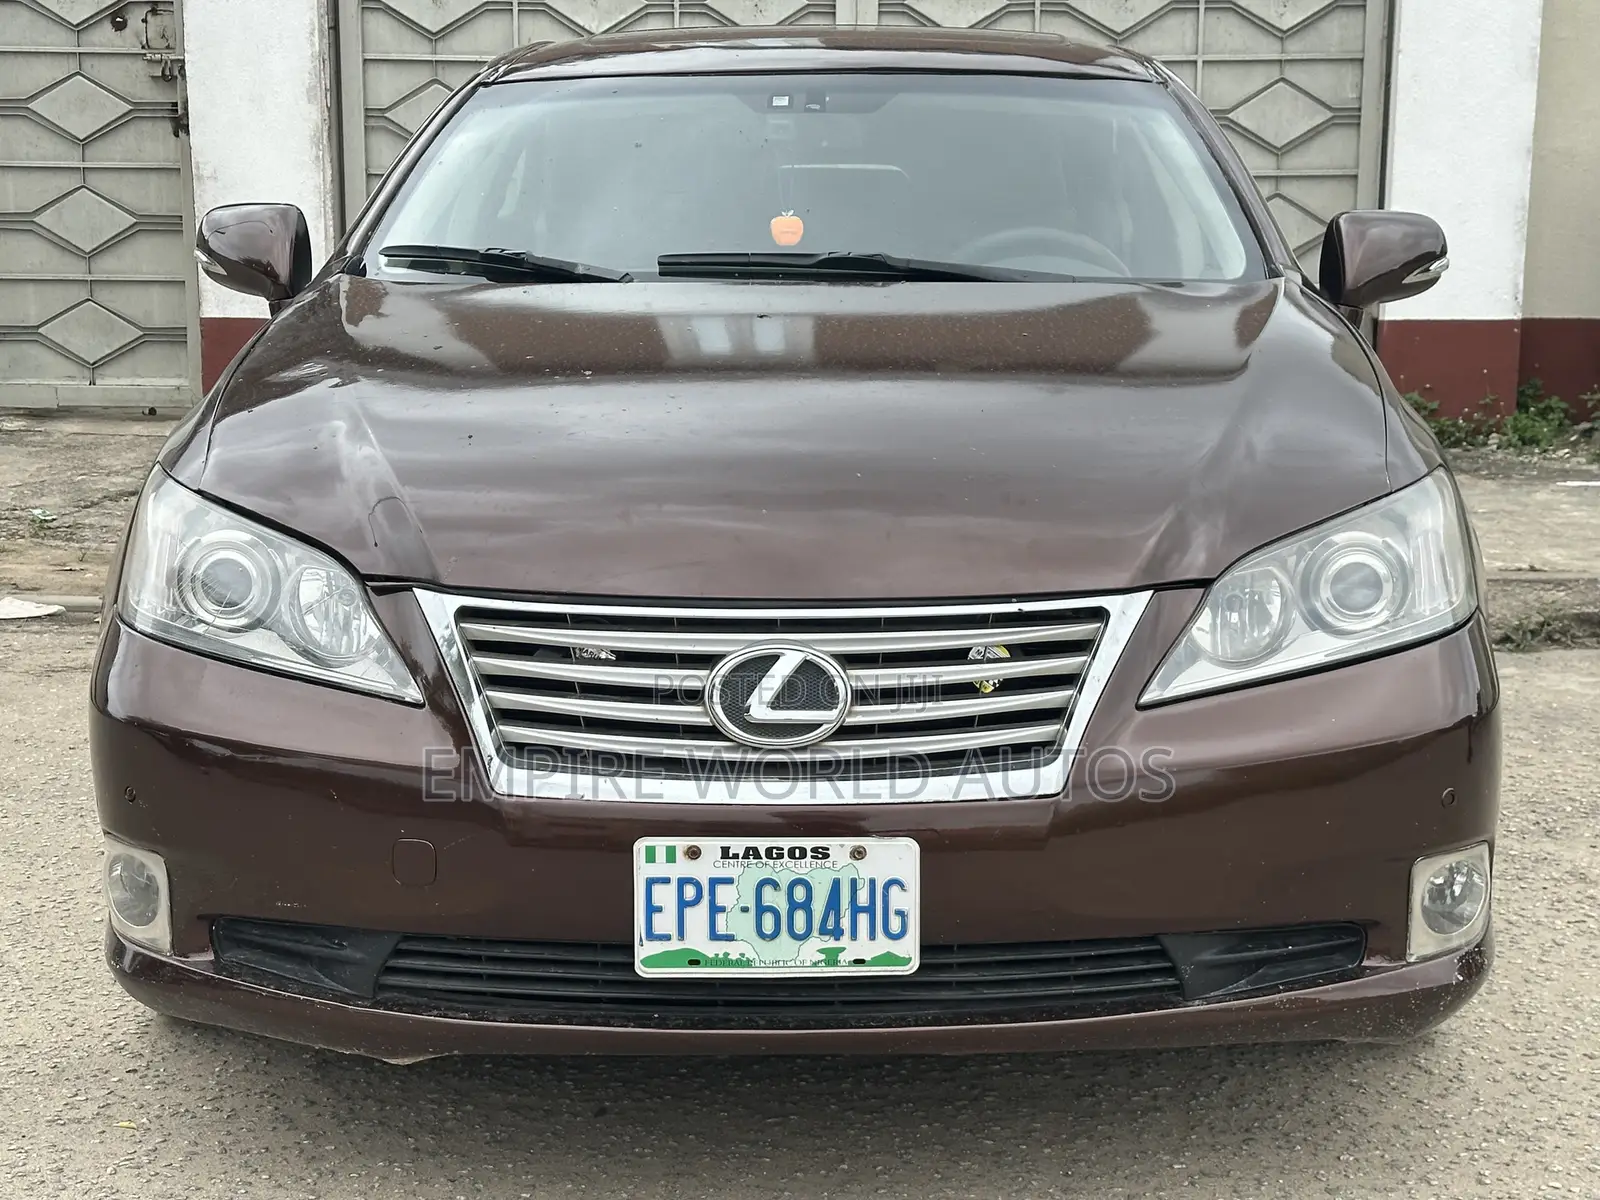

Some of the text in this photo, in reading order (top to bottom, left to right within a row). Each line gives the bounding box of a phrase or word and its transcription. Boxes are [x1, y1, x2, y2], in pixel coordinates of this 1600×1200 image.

[720, 845, 831, 860] LAGOS
[713, 860, 838, 869] CENTRE OF EXCELLENCE
[644, 876, 910, 942] EPE-684HG
[704, 958, 747, 967] FEDERAL
